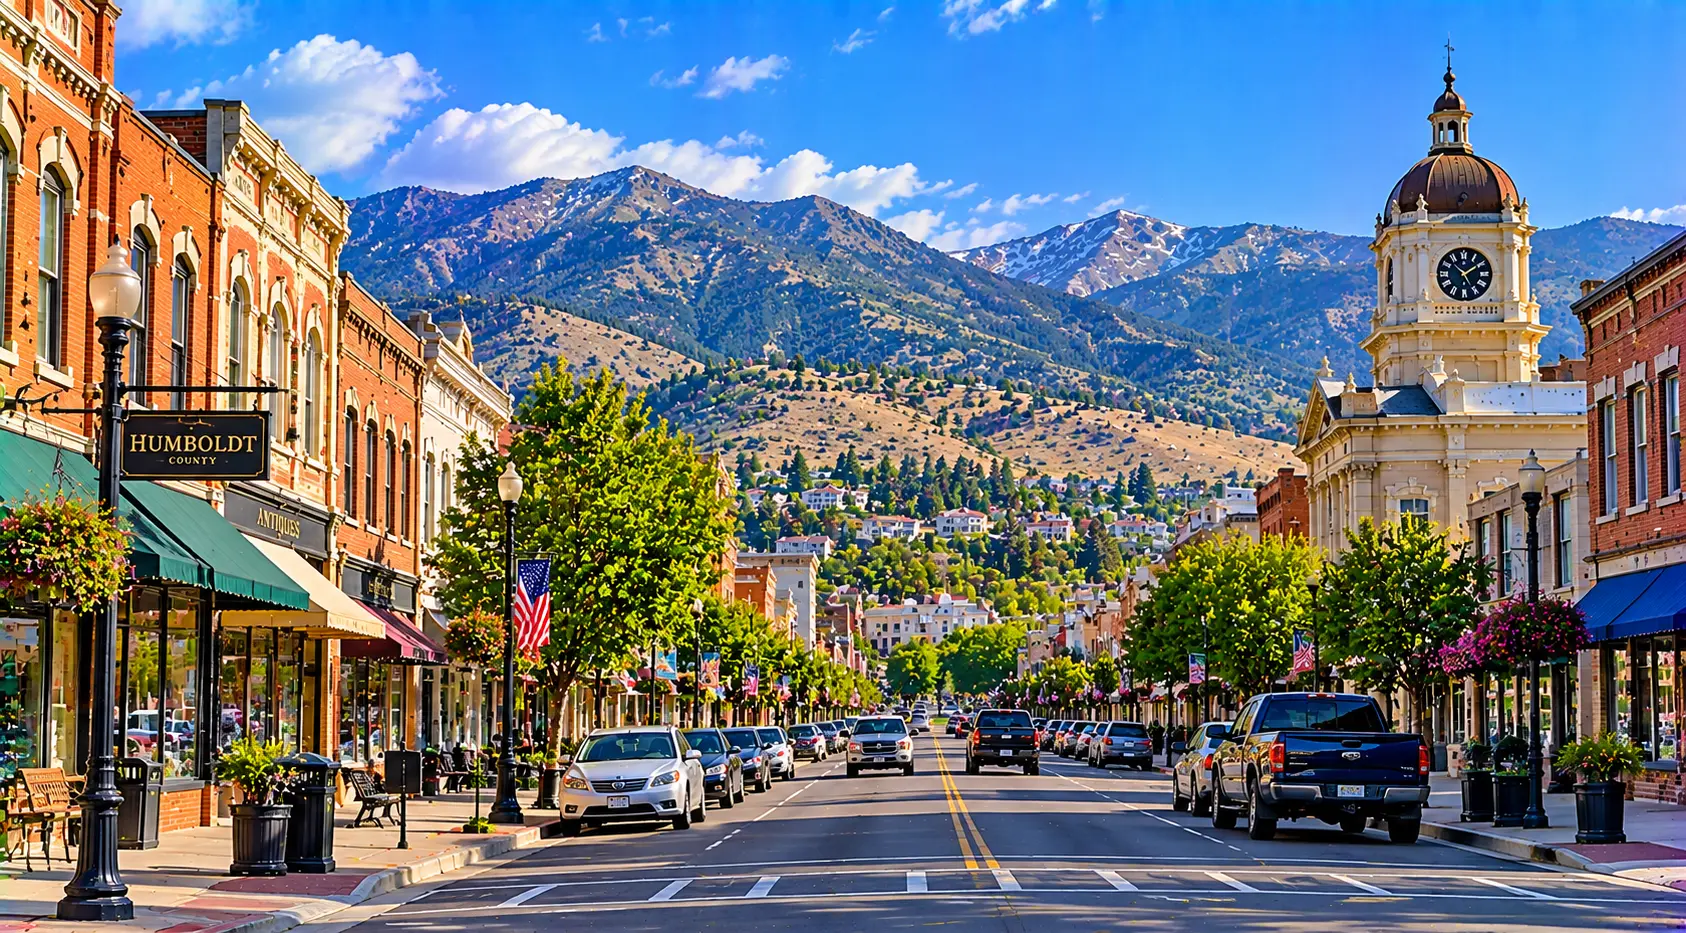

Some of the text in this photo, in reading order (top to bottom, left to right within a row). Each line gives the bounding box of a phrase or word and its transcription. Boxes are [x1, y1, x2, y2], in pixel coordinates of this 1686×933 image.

[129, 434, 257, 452] HUMBOLDT
[168, 456, 216, 464] COUNTY
[257, 507, 299, 539] ANTIQUES
